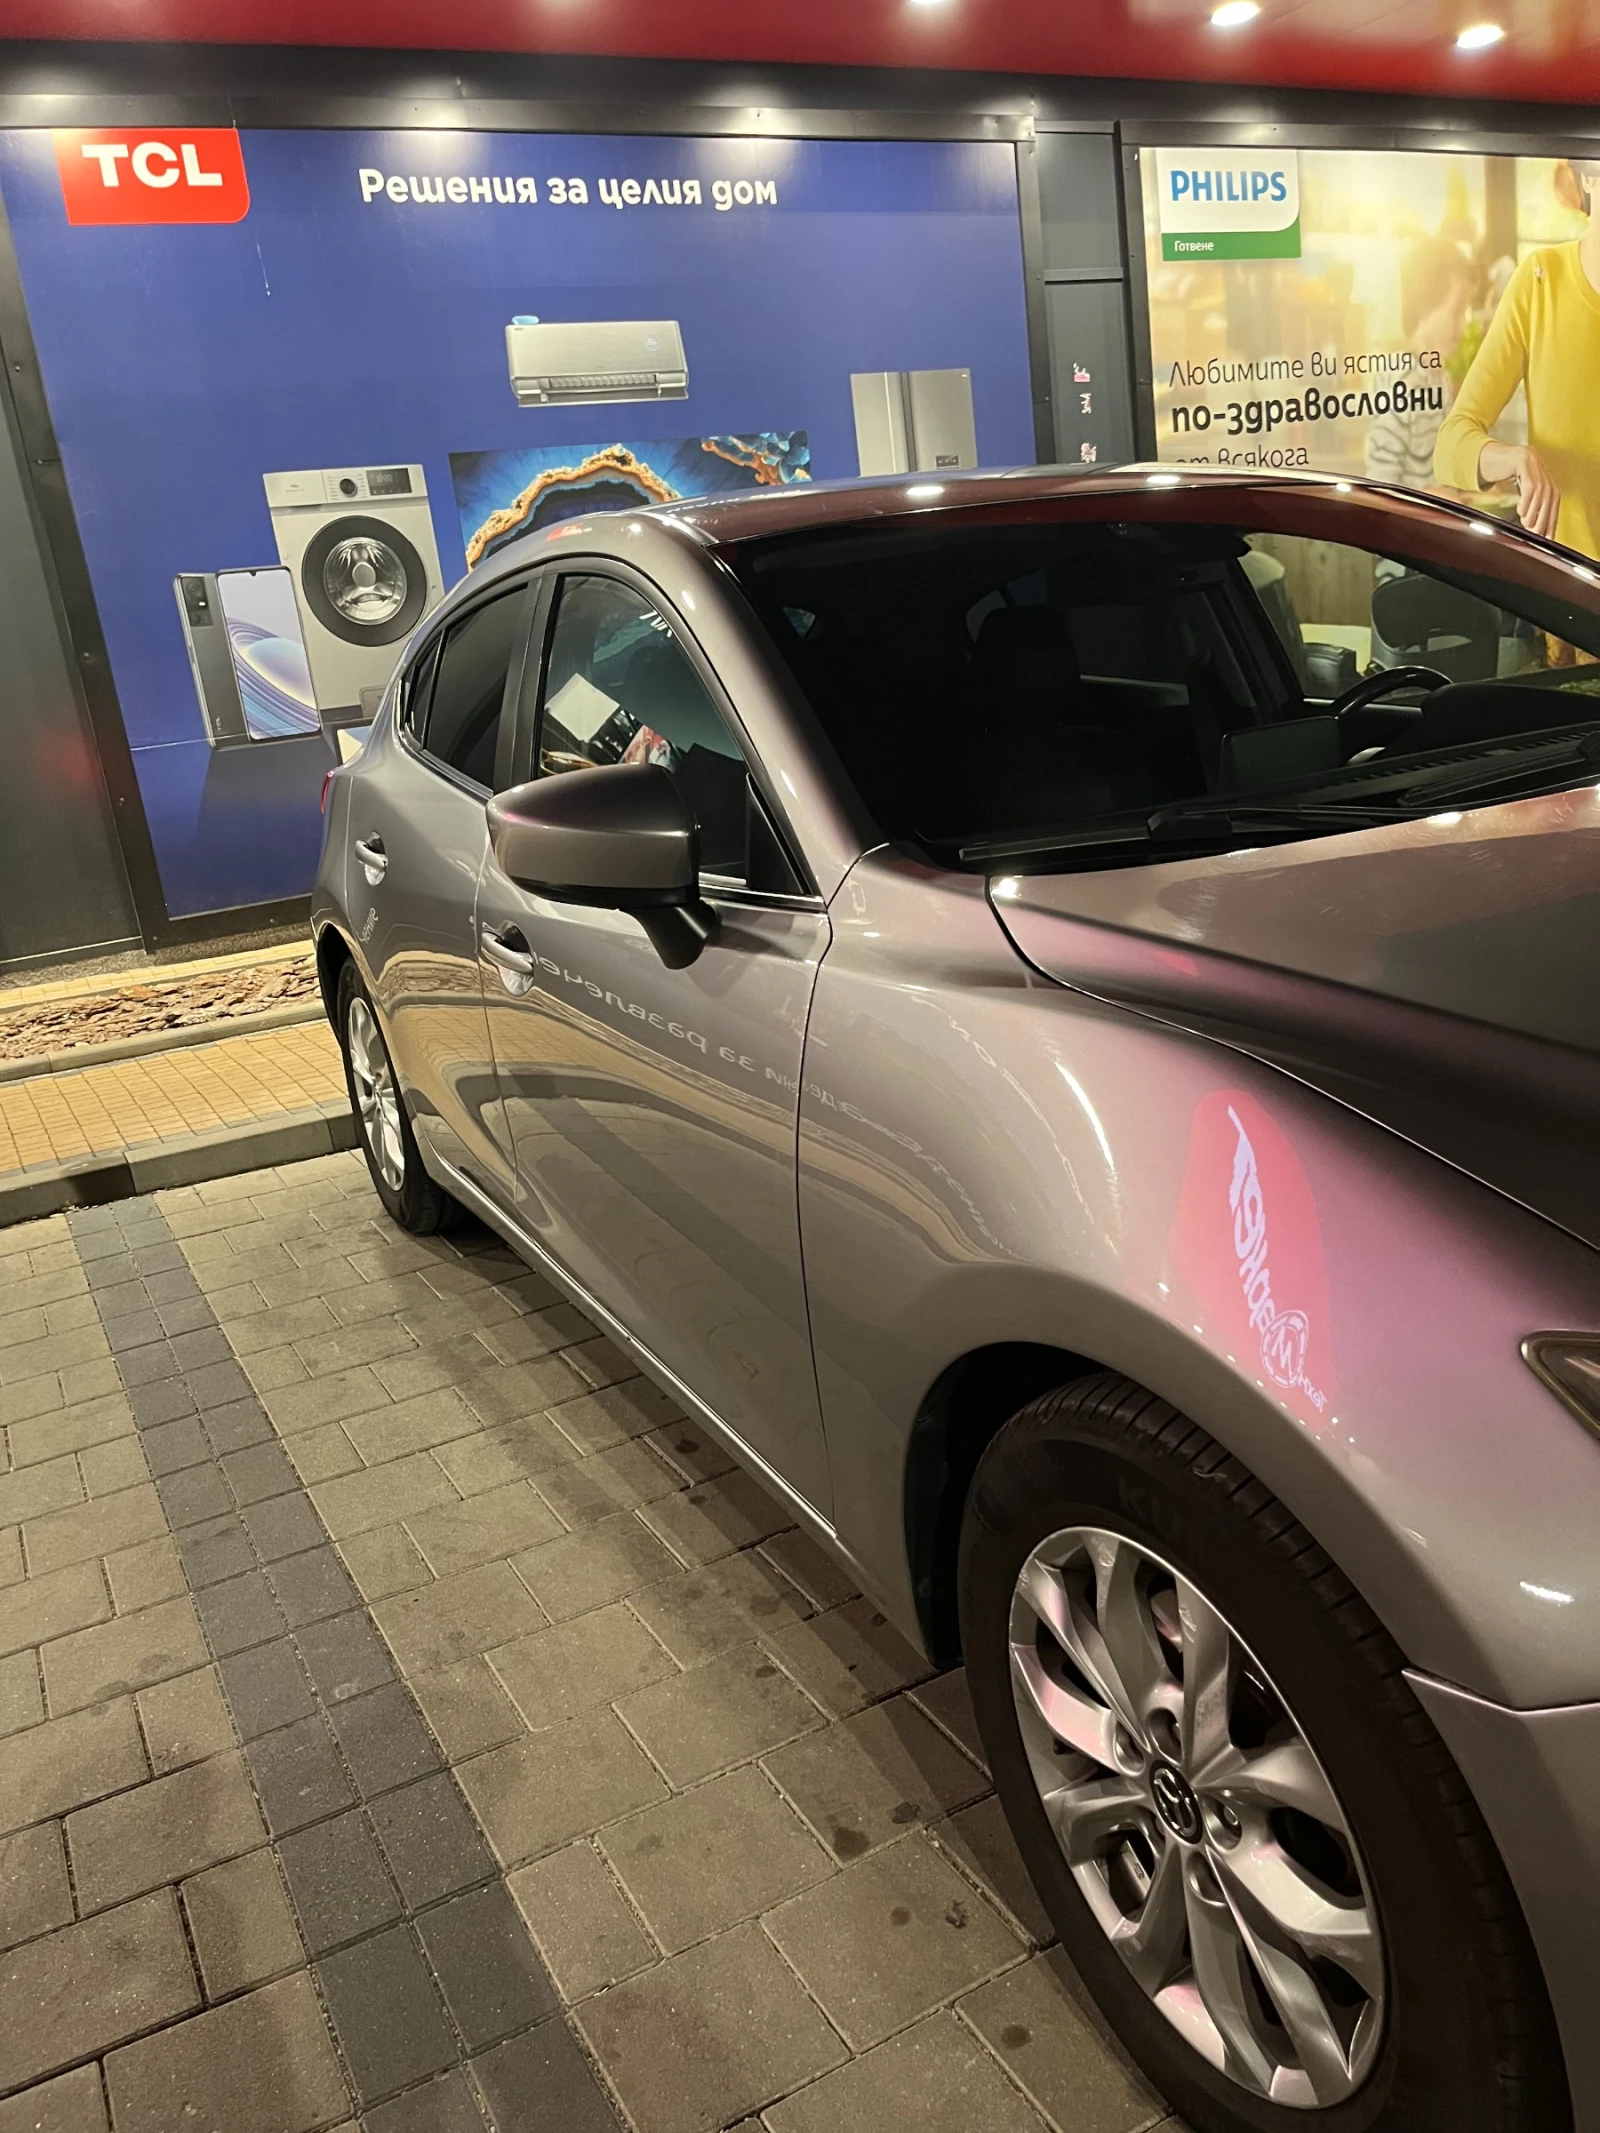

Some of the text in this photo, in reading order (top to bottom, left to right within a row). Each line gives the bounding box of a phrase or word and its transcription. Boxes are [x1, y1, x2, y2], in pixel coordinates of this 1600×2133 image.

[80, 141, 223, 188] TCL
[358, 168, 778, 211] Решения за целия дом
[1170, 170, 1288, 202] PHILIPS
[1174, 240, 1215, 252] Готвене
[1169, 350, 1443, 388] Любимите ви ястия са
[1172, 380, 1443, 436] по-здравословни
